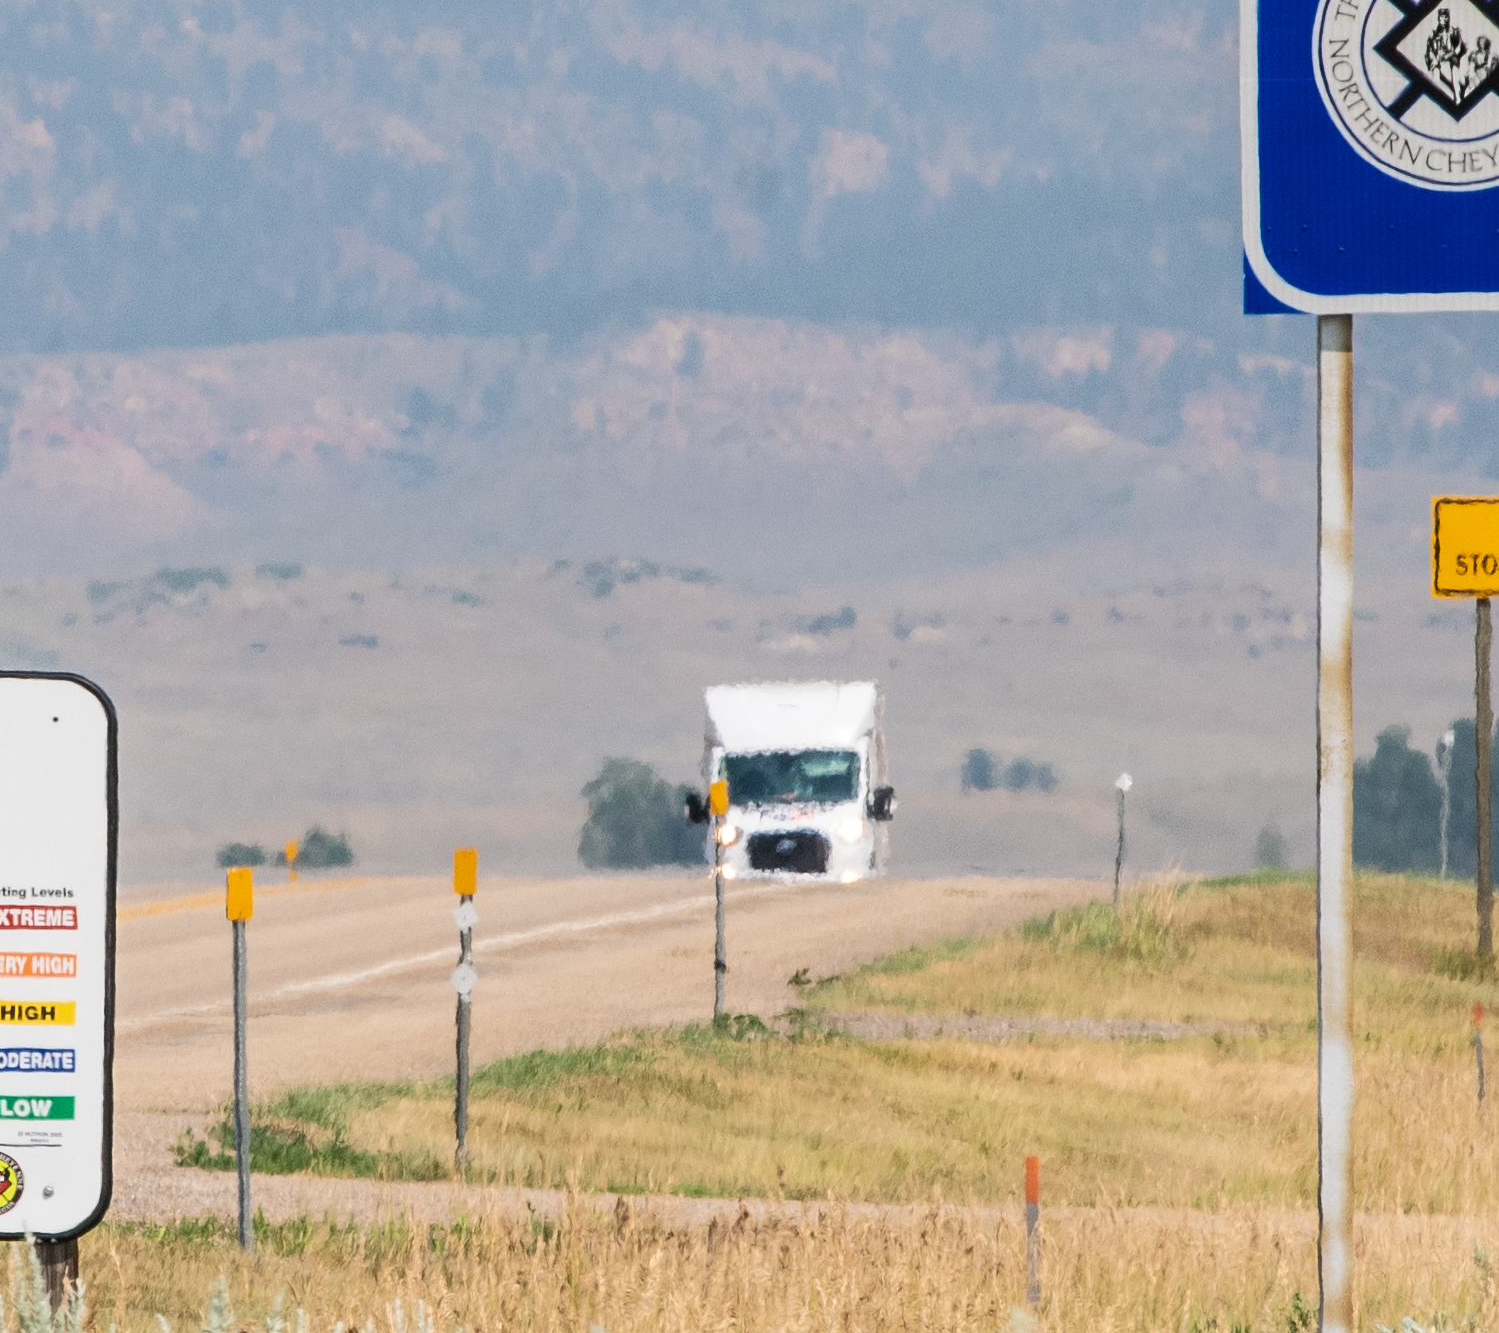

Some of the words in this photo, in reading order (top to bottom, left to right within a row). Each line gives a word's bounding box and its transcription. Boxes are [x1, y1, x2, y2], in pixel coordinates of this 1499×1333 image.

[1329, 37, 1423, 165] NORTHERN
[30, 887, 74, 898] Levels
[32, 956, 74, 974] HIGH
[0, 1005, 56, 1021] HIGH
[0, 1099, 52, 1117] LOW
